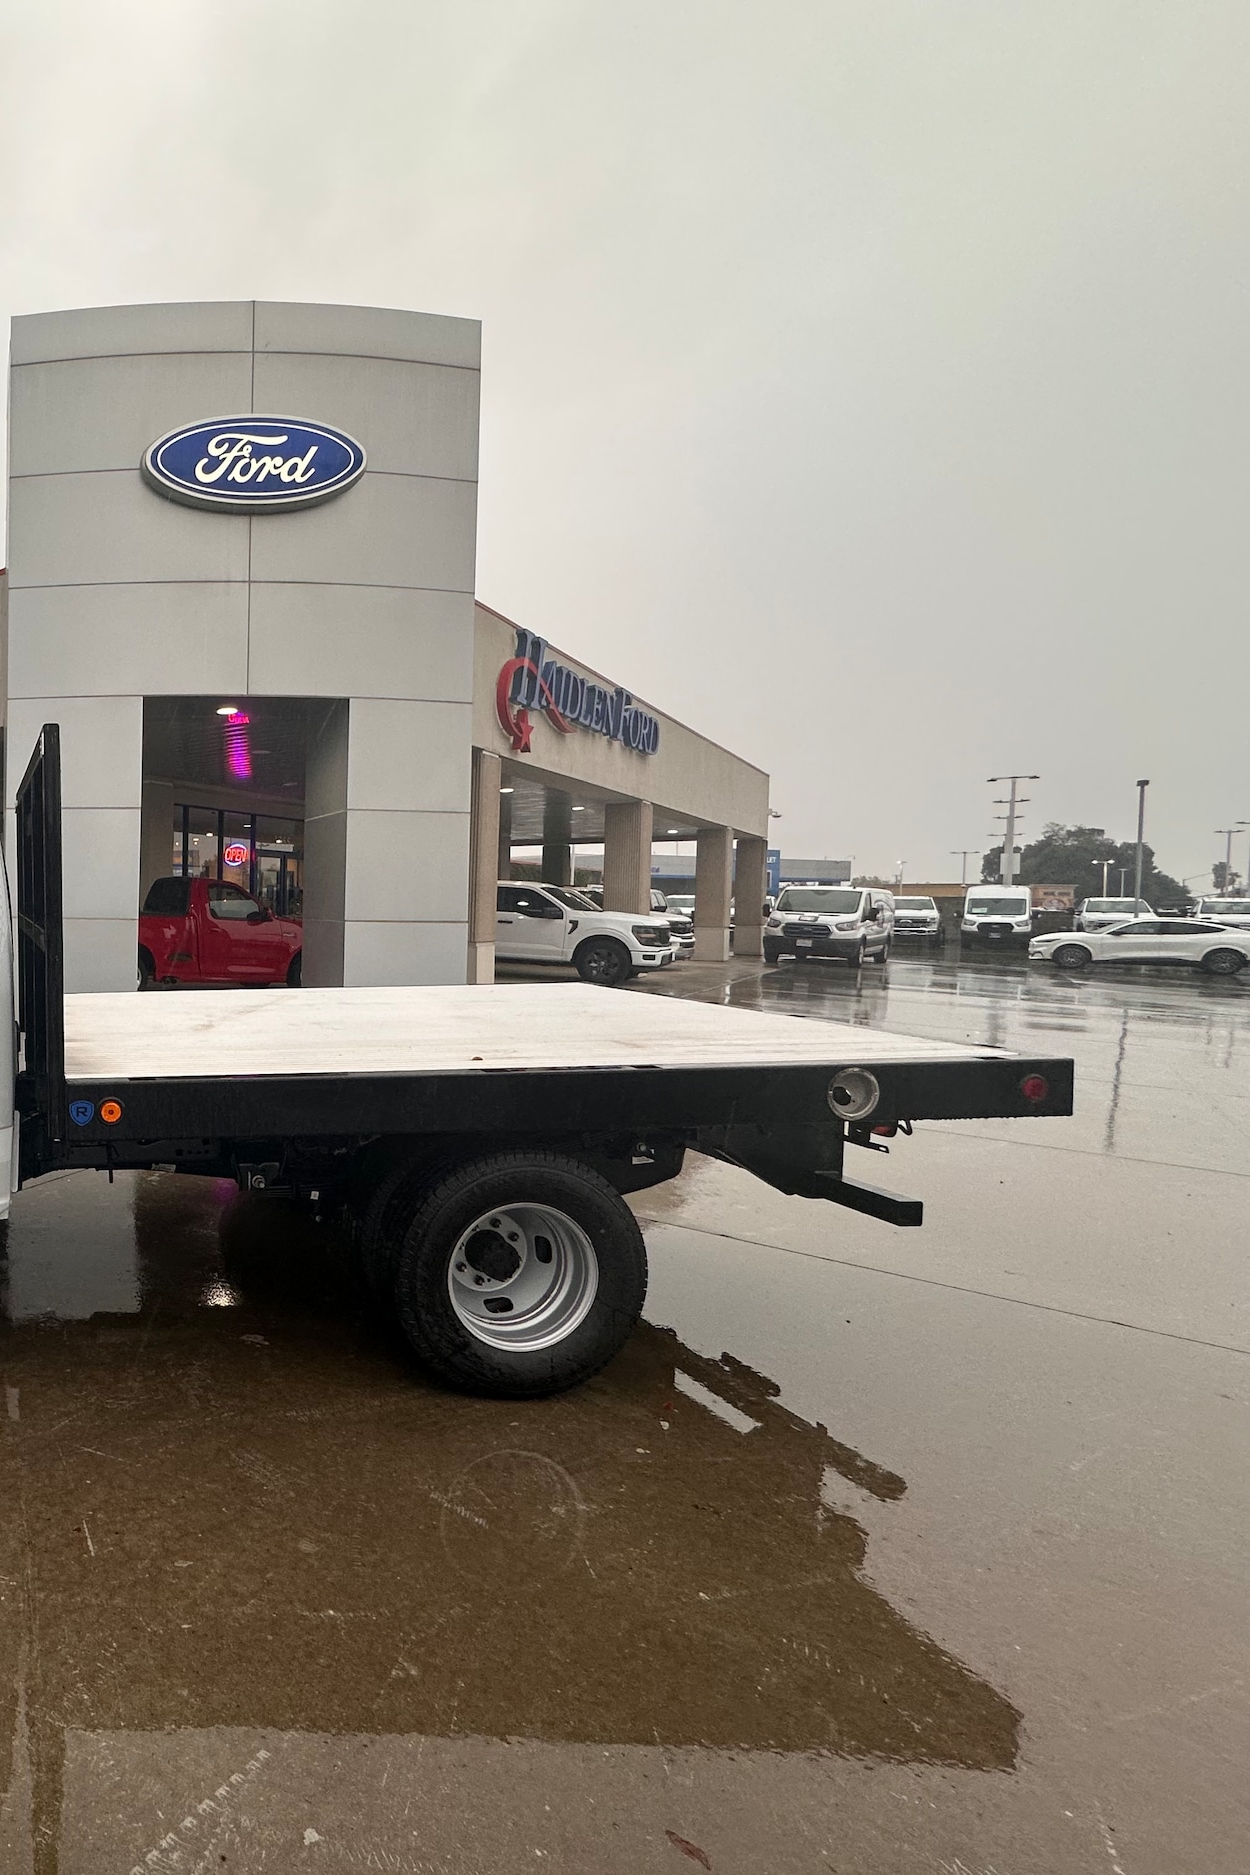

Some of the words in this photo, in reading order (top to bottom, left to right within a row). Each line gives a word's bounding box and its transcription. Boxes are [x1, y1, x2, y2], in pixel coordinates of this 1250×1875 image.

[195, 433, 319, 483] Ford
[509, 629, 616, 739] HAIDLEN
[611, 687, 660, 755] FORD
[225, 848, 247, 862] OPEN
[76, 1106, 88, 1117] R
